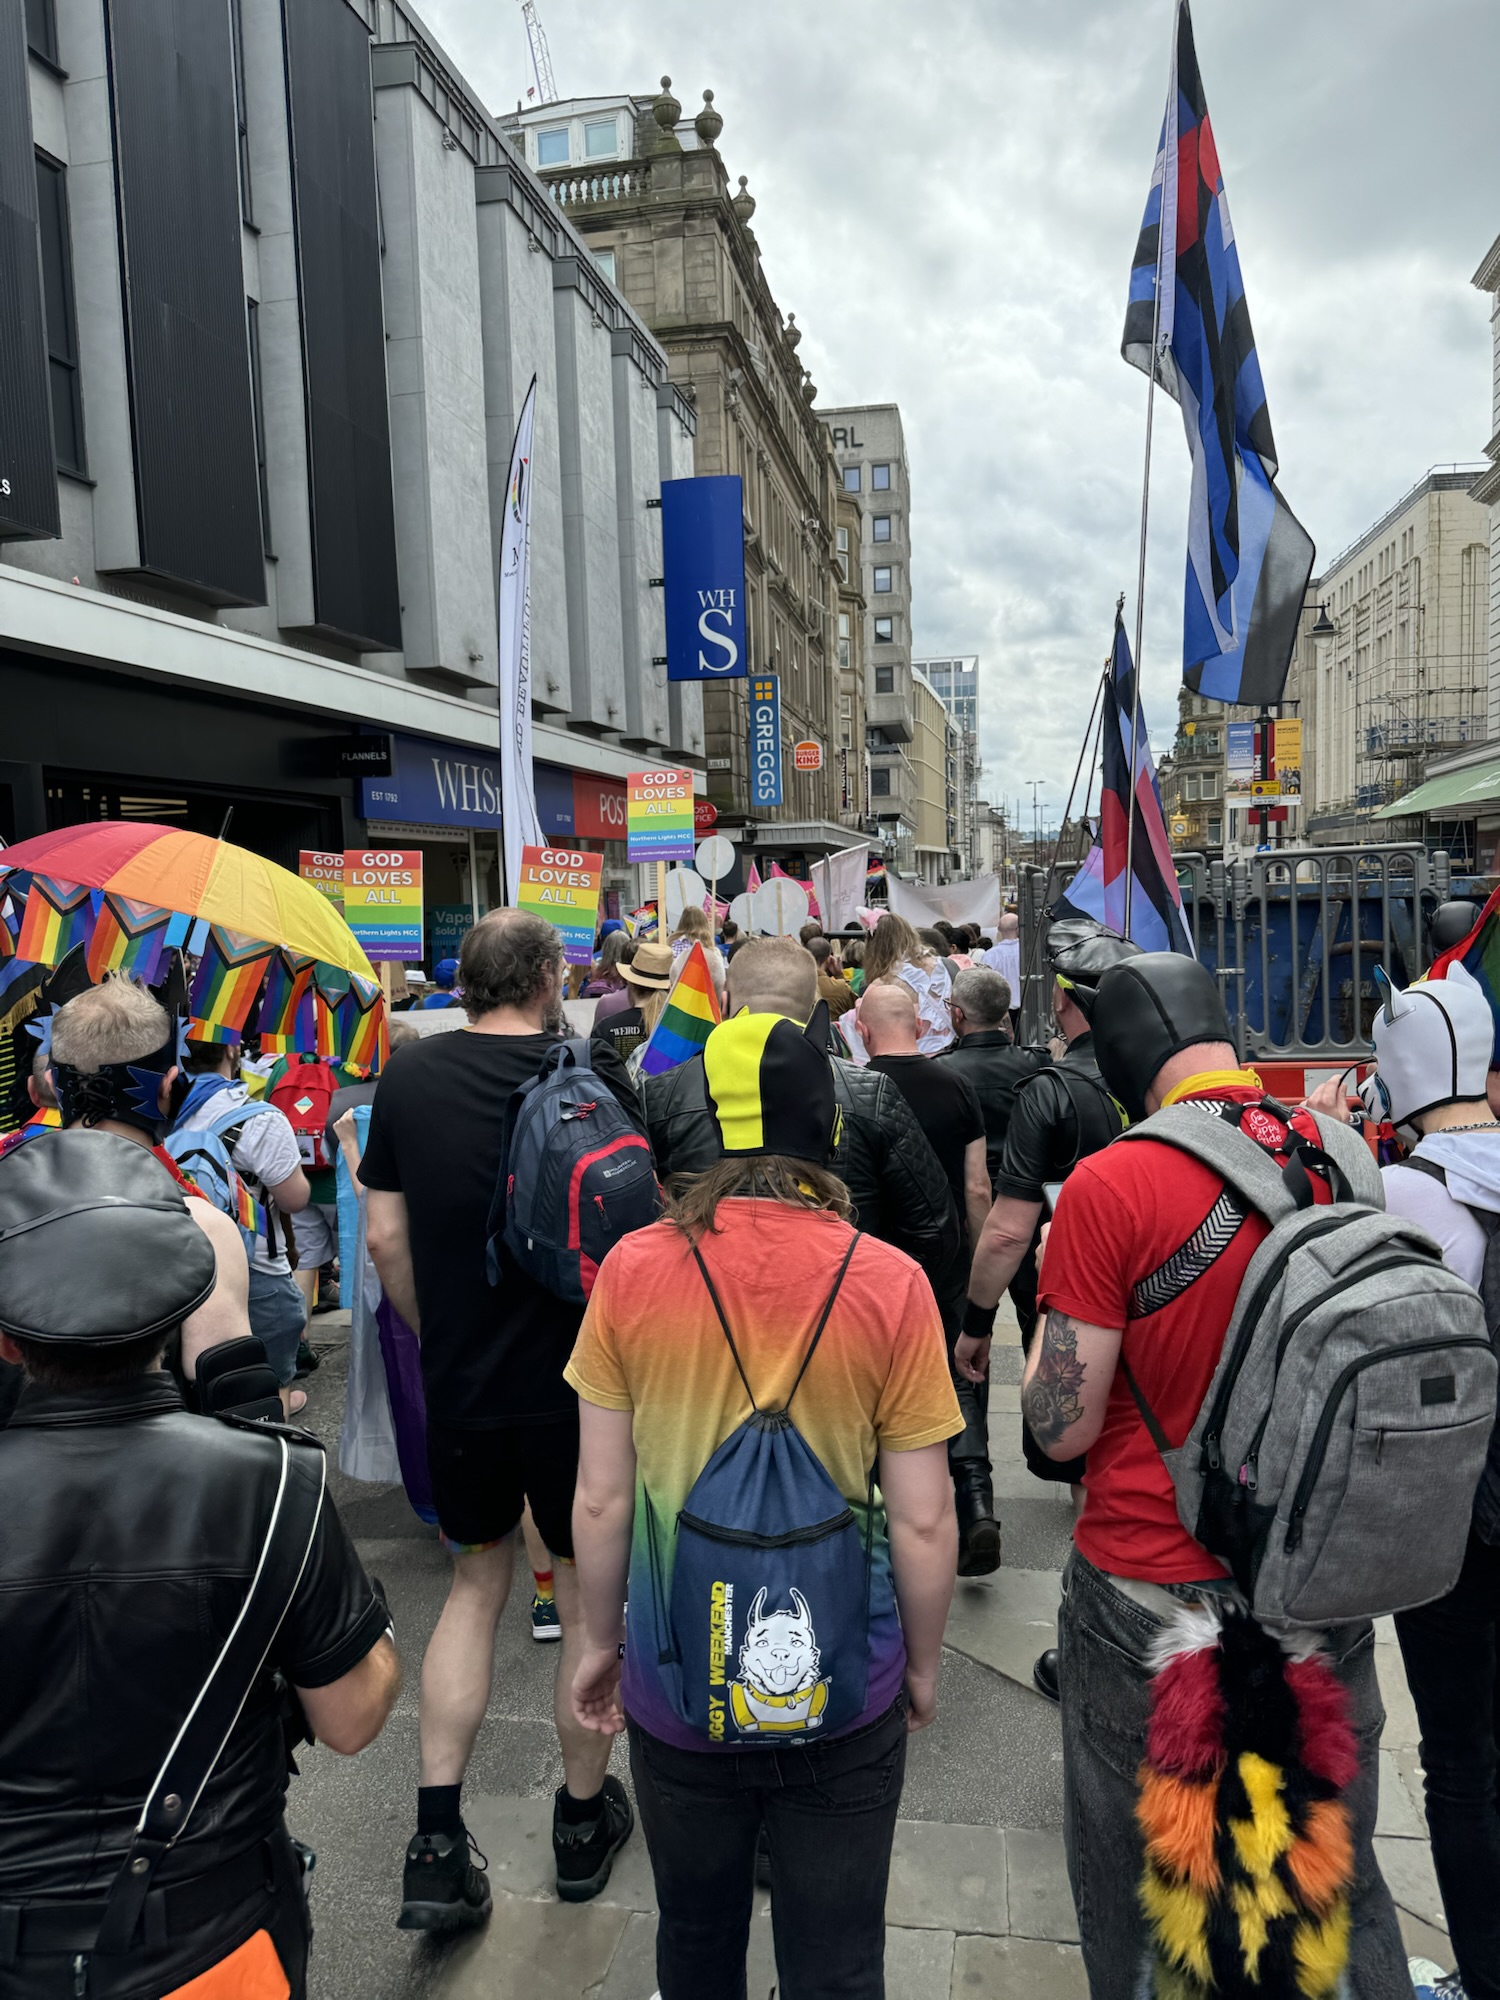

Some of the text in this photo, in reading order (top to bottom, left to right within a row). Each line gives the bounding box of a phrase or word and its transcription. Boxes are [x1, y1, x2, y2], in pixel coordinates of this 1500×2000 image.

[697, 589, 736, 608] WH
[698, 608, 738, 671] S
[341, 751, 387, 761] FLANNELS
[755, 705, 776, 800] GREGGS
[795, 756, 820, 764] KING
[642, 772, 678, 785] GOD
[371, 790, 383, 801] EST
[634, 787, 686, 800] LOVES
[645, 802, 676, 815] ALL
[694, 806, 709, 814] OST
[657, 834, 676, 842] Lights
[313, 854, 344, 868] GOD
[361, 853, 404, 867] GOD
[540, 850, 584, 868] GOD
[305, 867, 344, 881] LOVE
[352, 871, 413, 885] LOVES
[528, 867, 591, 888] LOVES
[315, 882, 341, 894] ALL
[365, 890, 401, 904] ALL
[539, 888, 577, 905] ALL
[379, 929, 401, 937] Lights
[435, 927, 456, 935] Sold
[575, 932, 591, 940] MCC
[1249, 1122, 1280, 1135] Puppy
[1256, 1133, 1282, 1144] Pride
[724, 1583, 734, 1656] MANCHESTER
[708, 1580, 726, 1743] OGGY WEEKEND
